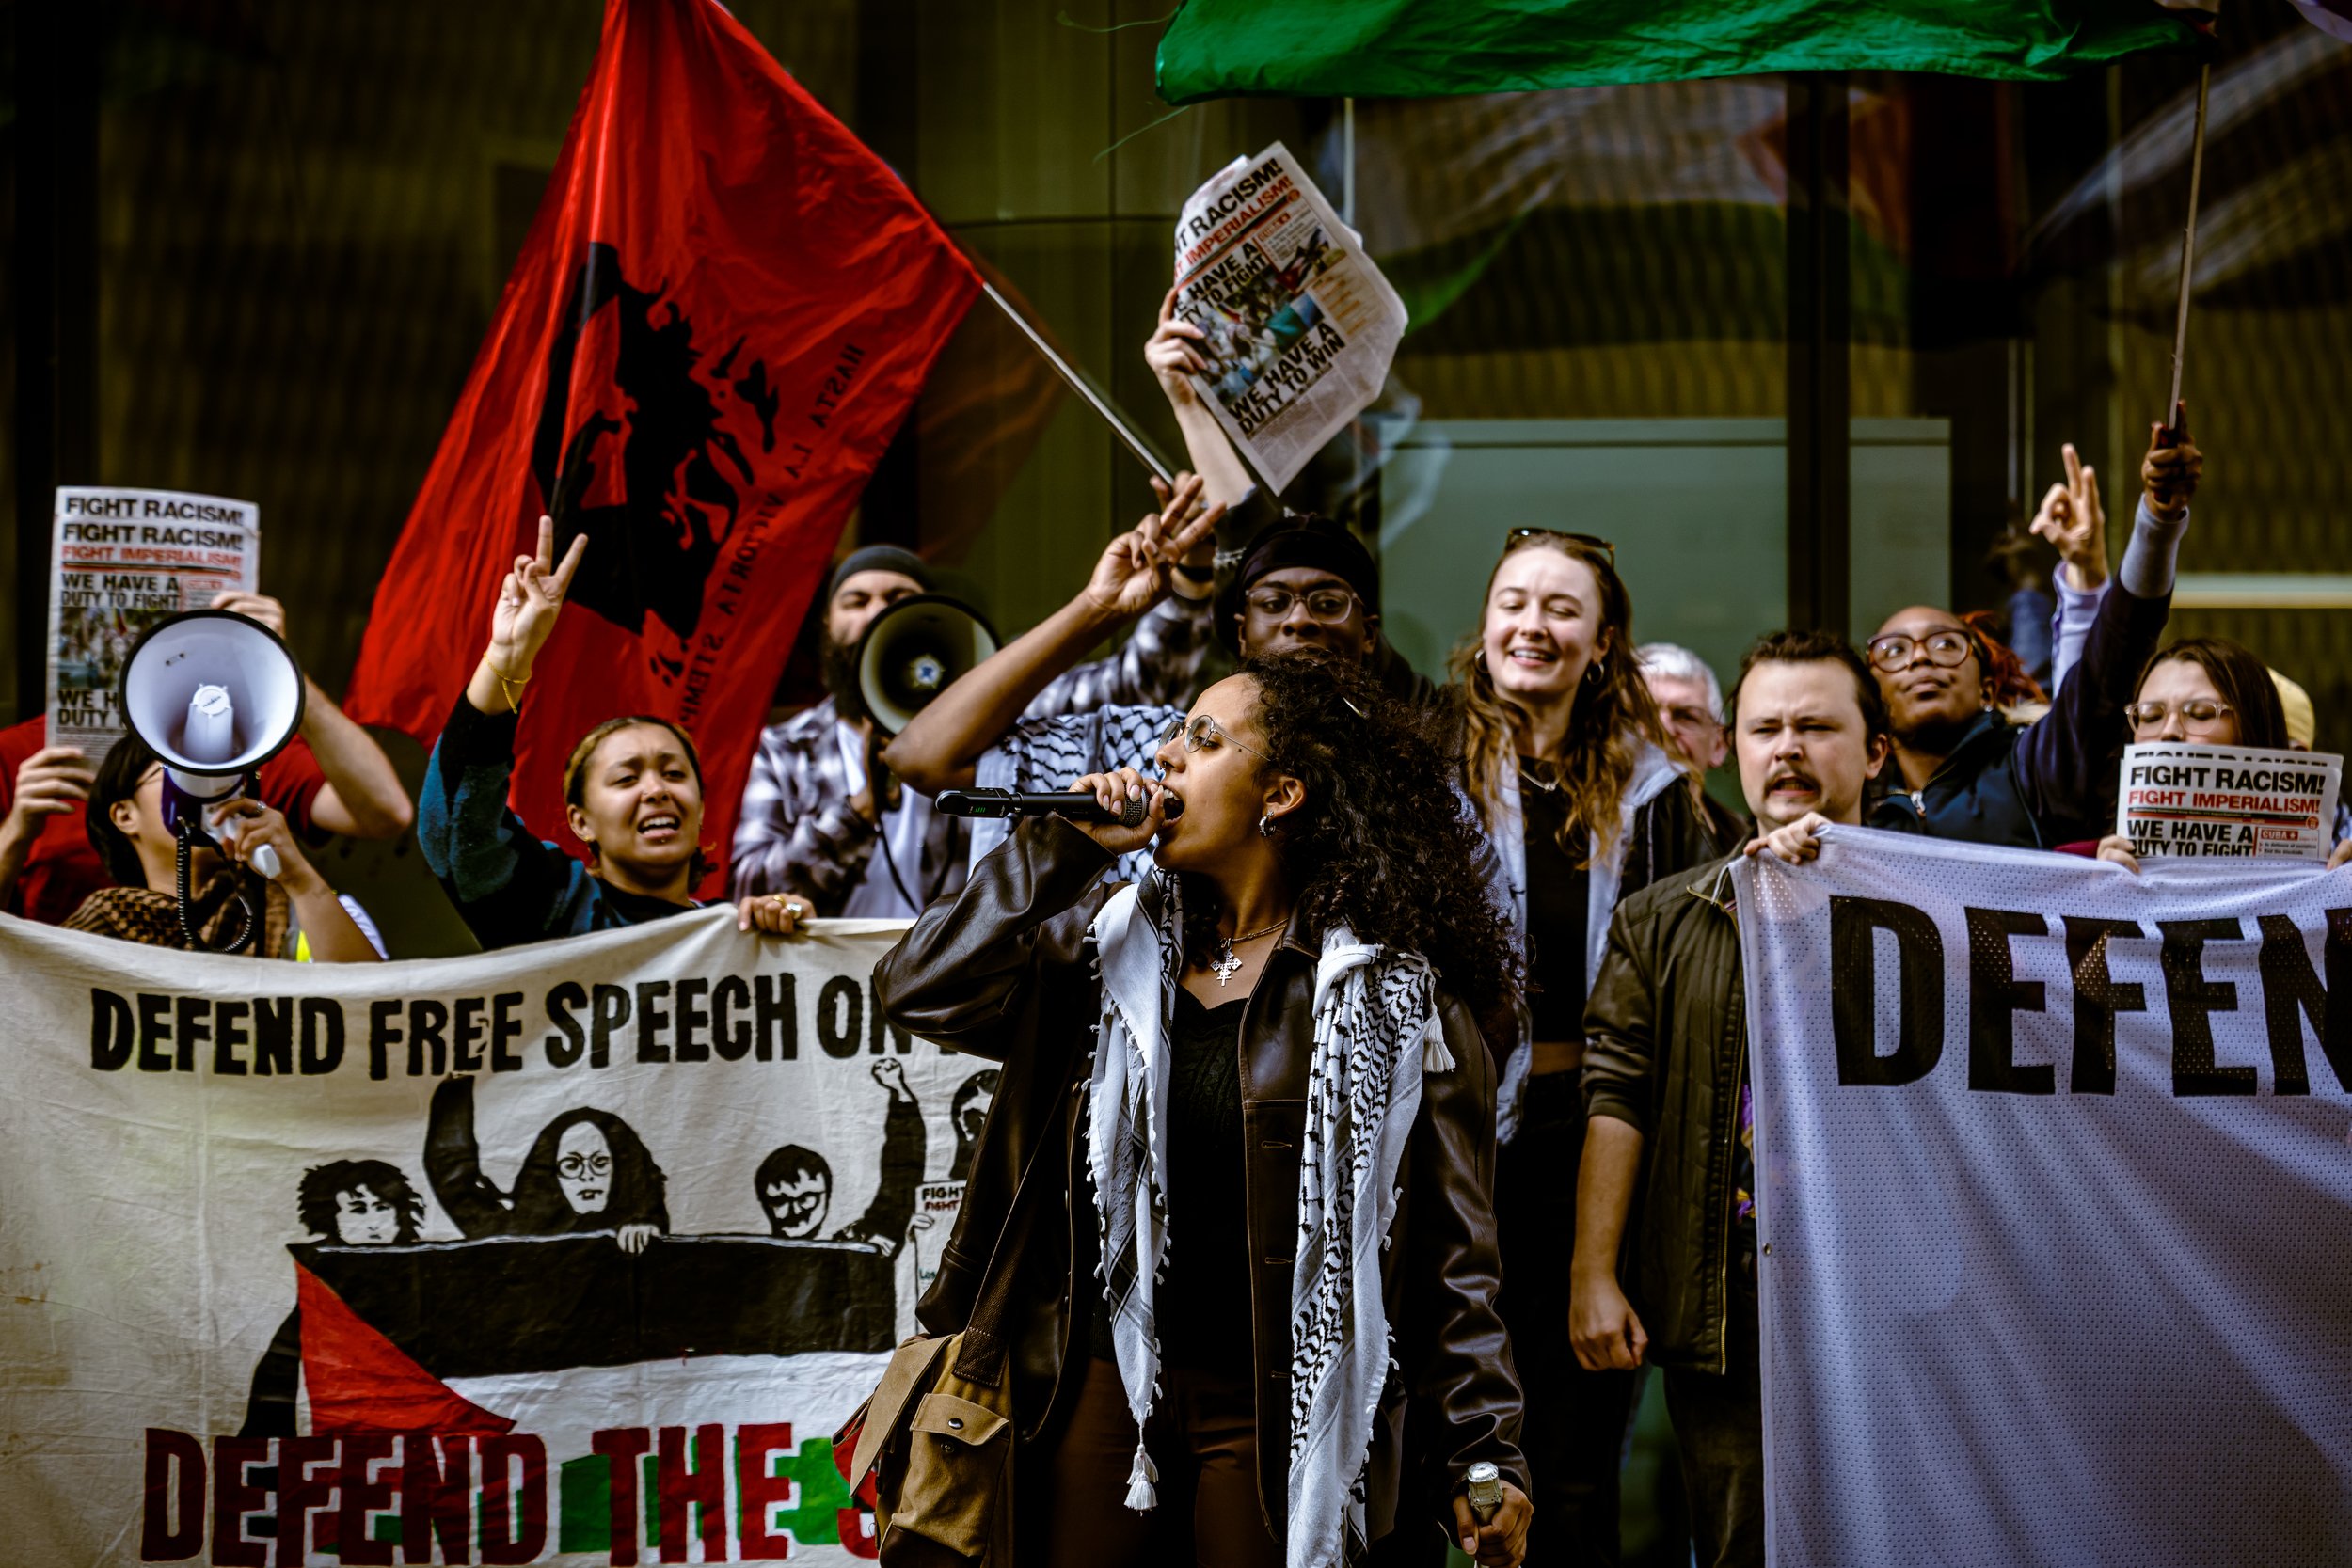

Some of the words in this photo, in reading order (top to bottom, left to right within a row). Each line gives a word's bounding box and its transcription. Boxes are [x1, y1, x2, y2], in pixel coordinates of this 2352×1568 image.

[1189, 157, 1284, 238] RACISM!
[1184, 176, 1294, 265] IMPERIALISM!
[1187, 254, 1241, 301] HAVE
[1242, 242, 1259, 259] A
[1203, 288, 1224, 309] TO
[1222, 252, 1269, 294] FIGHT
[1228, 386, 1262, 422] WE
[1266, 340, 1315, 390] HAVE
[1318, 322, 1336, 337] A
[1238, 394, 1281, 435] DUTY
[1285, 366, 1308, 391] TO
[1306, 333, 1345, 374] WIN
[65, 497, 137, 517] FIGHT
[143, 499, 244, 526] RACISM!
[62, 523, 135, 543] FIGHT
[142, 527, 243, 551] RACISM!
[61, 545, 114, 561] FIGHT
[119, 547, 242, 567] IMPERIALISM!
[61, 573, 94, 590] WE
[103, 574, 158, 591] HAVE
[167, 576, 179, 591] A
[61, 591, 101, 609] DUTY
[108, 592, 126, 609] TO
[133, 593, 180, 610] FIGHT
[58, 690, 93, 707] WE
[58, 708, 109, 727] DUTY
[2130, 765, 2210, 788] FIGHT
[2216, 768, 2327, 795] RACISM!
[2128, 789, 2186, 807] FIGHT
[2192, 792, 2321, 814] IMPERIALISM!
[2127, 819, 2164, 838] WE
[2171, 821, 2233, 842] HAVE
[2238, 824, 2254, 843] A
[2262, 831, 2288, 840] CUBA
[2175, 840, 2197, 858] TO
[2202, 842, 2253, 857] FIGHT
[89, 987, 345, 1076] DEFEND
[368, 990, 524, 1081] FREE
[545, 973, 797, 1069] SPEECH
[925, 1199, 961, 1212] FIGHT
[141, 1427, 548, 1568] DEFEND
[593, 1422, 794, 1568] THE
